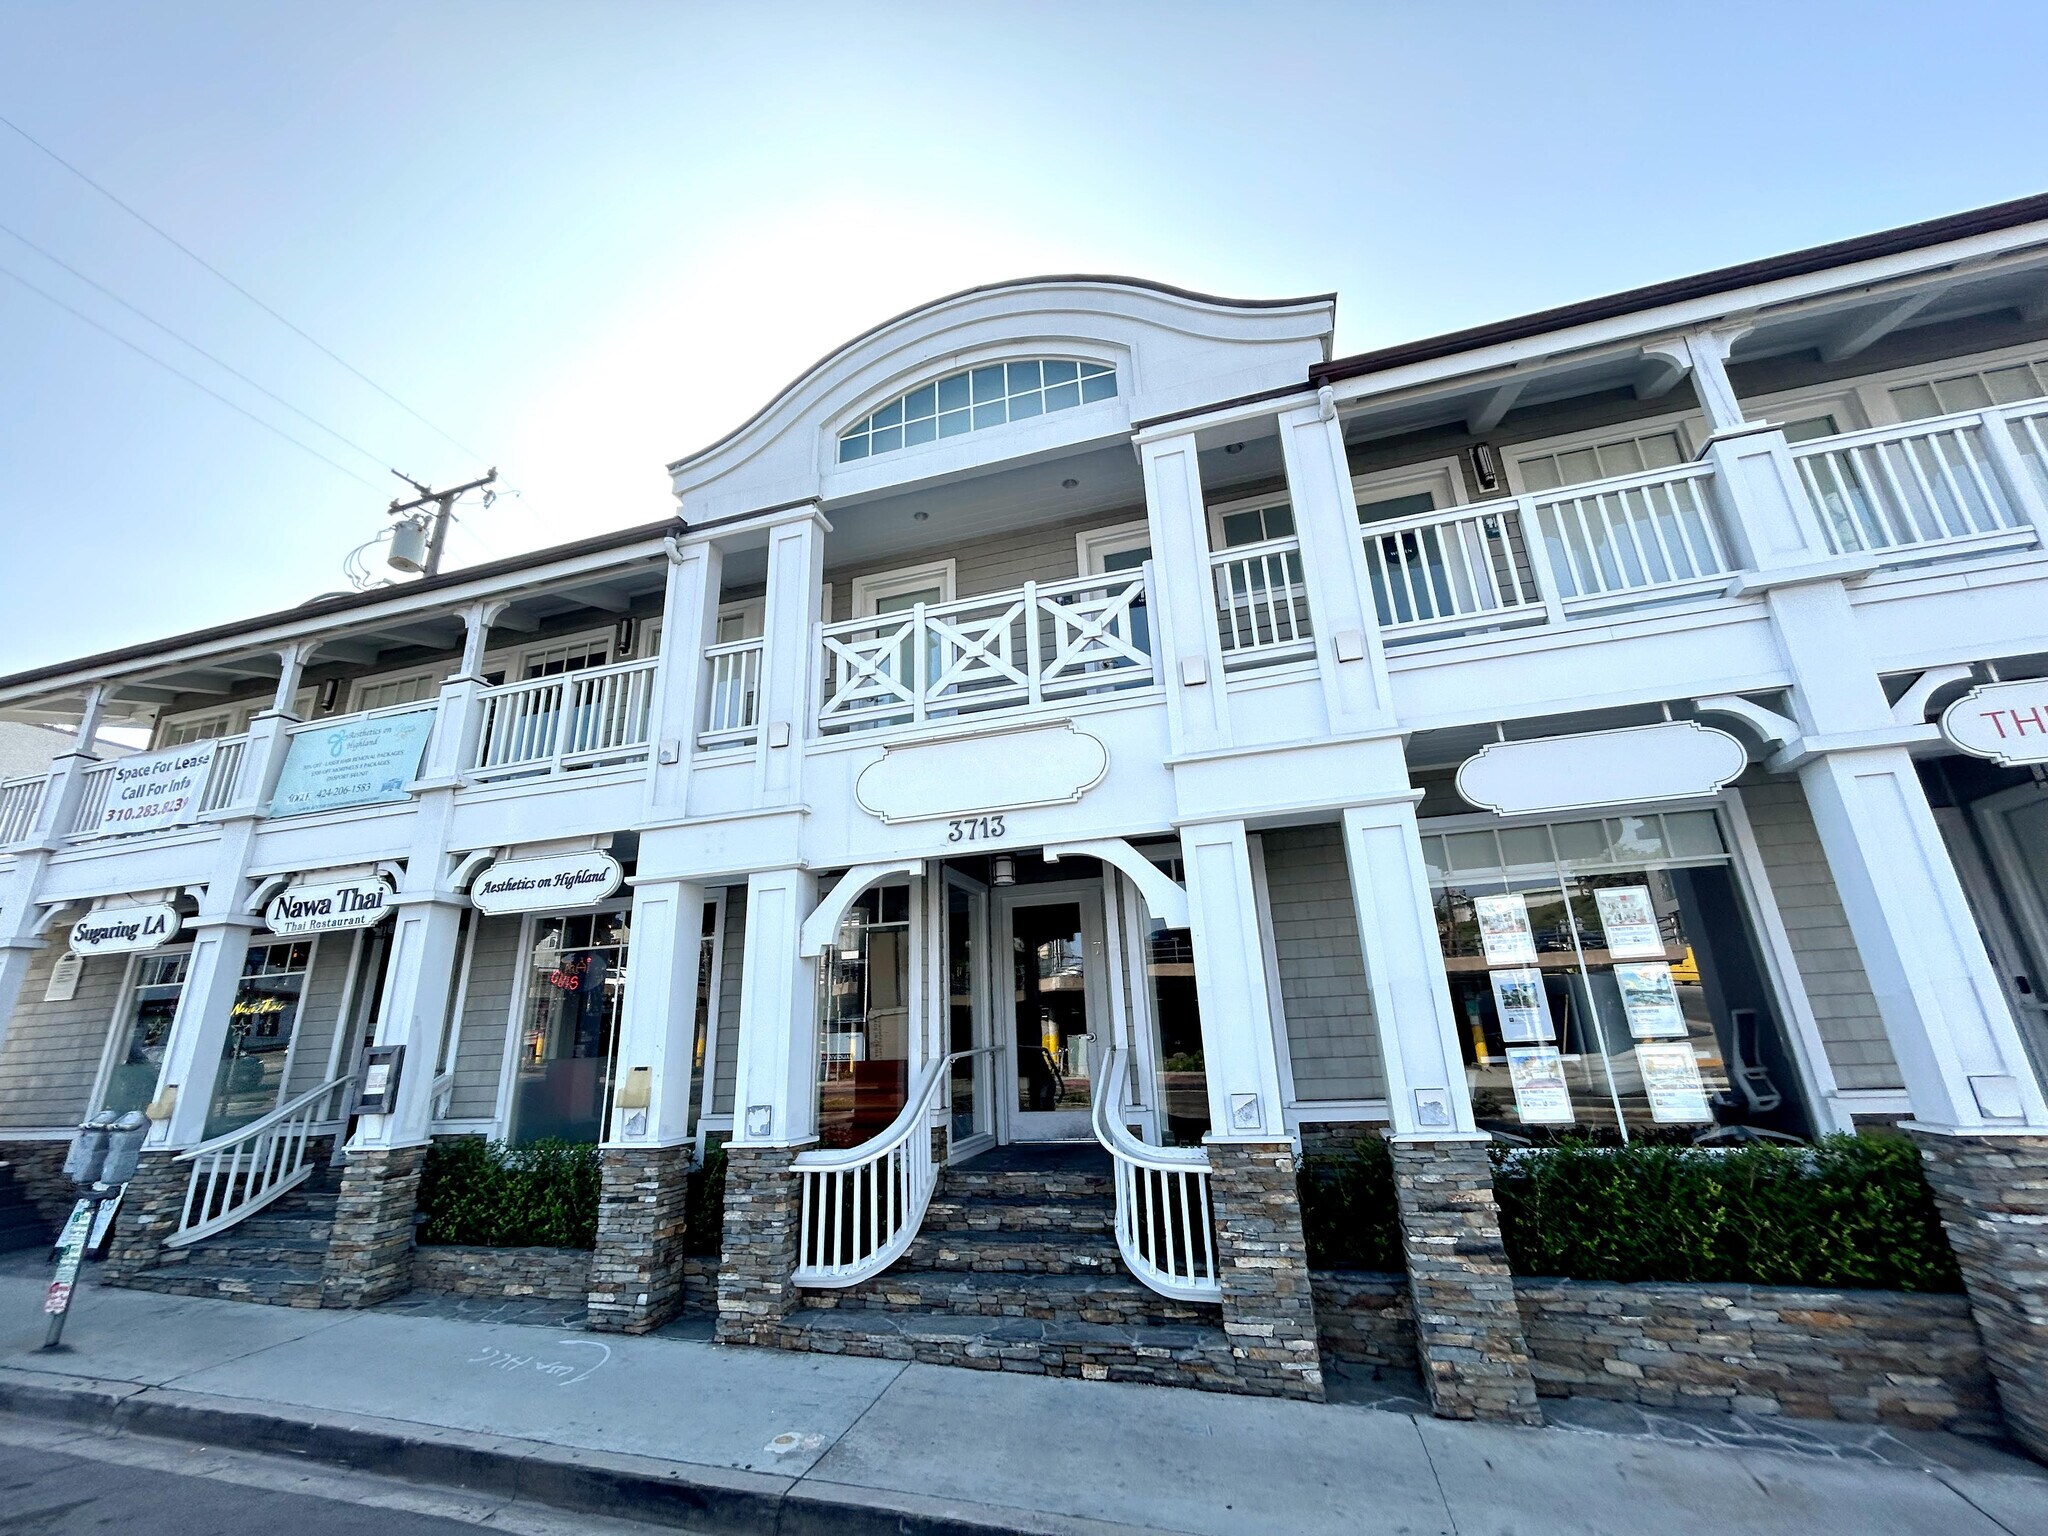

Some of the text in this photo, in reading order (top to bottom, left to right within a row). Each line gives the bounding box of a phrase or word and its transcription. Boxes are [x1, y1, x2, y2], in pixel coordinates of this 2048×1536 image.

[1980, 705, 2048, 738] TH
[364, 759, 390, 768] PACKAGES
[377, 750, 404, 758] PACKAGES
[116, 754, 210, 783] Space For Lease
[121, 776, 191, 801] Call For Info
[316, 782, 371, 799] 424-206-1583
[948, 815, 1005, 841] 3713
[479, 867, 610, 896] Aesthetics on Highland
[274, 887, 384, 920] Nawa Thai
[74, 914, 165, 944] Sugaring LA
[285, 915, 365, 932] Thai Restaurant
